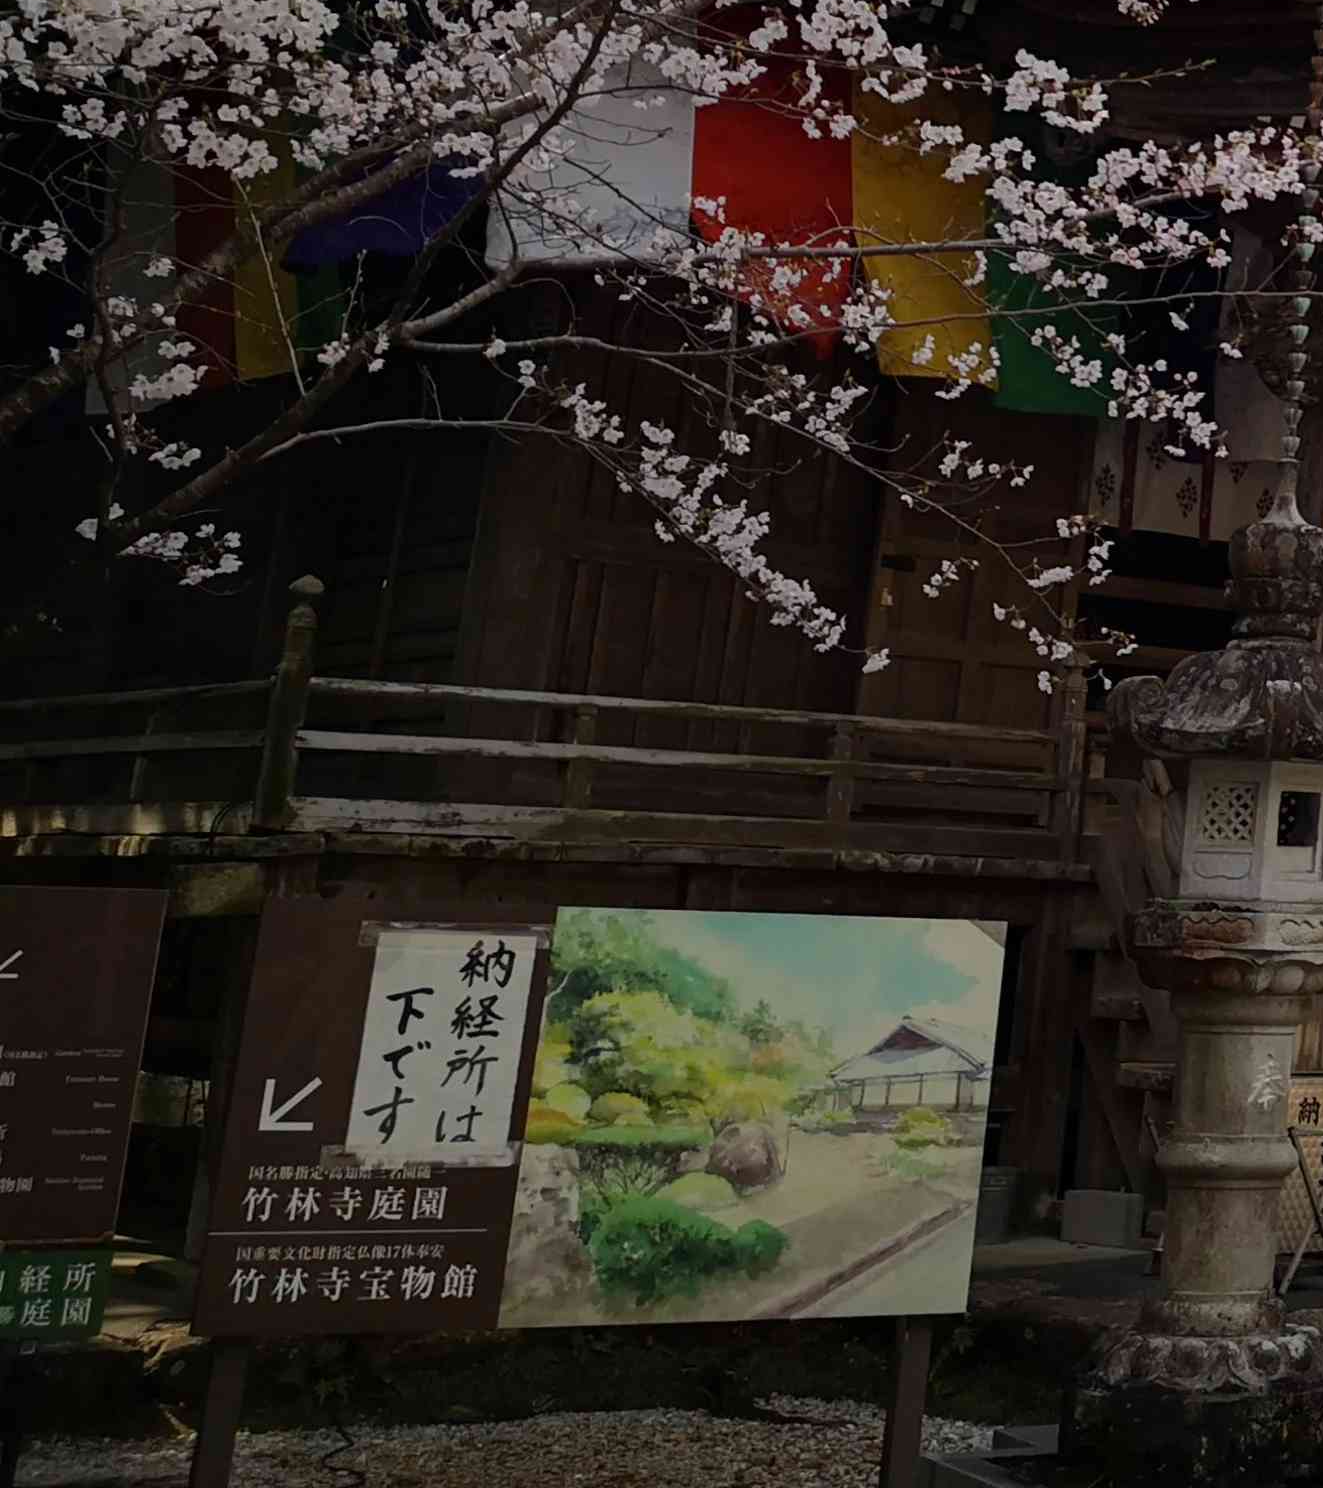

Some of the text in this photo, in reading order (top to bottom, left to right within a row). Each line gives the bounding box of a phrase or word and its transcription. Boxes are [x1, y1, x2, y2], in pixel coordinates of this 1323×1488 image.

[435, 940, 516, 1143] 納経所は
[363, 987, 435, 1145] 下です
[241, 1185, 449, 1223] 竹林寺庭園
[0, 1263, 96, 1293] 経所
[228, 1264, 479, 1305] 竹林寺宝物館
